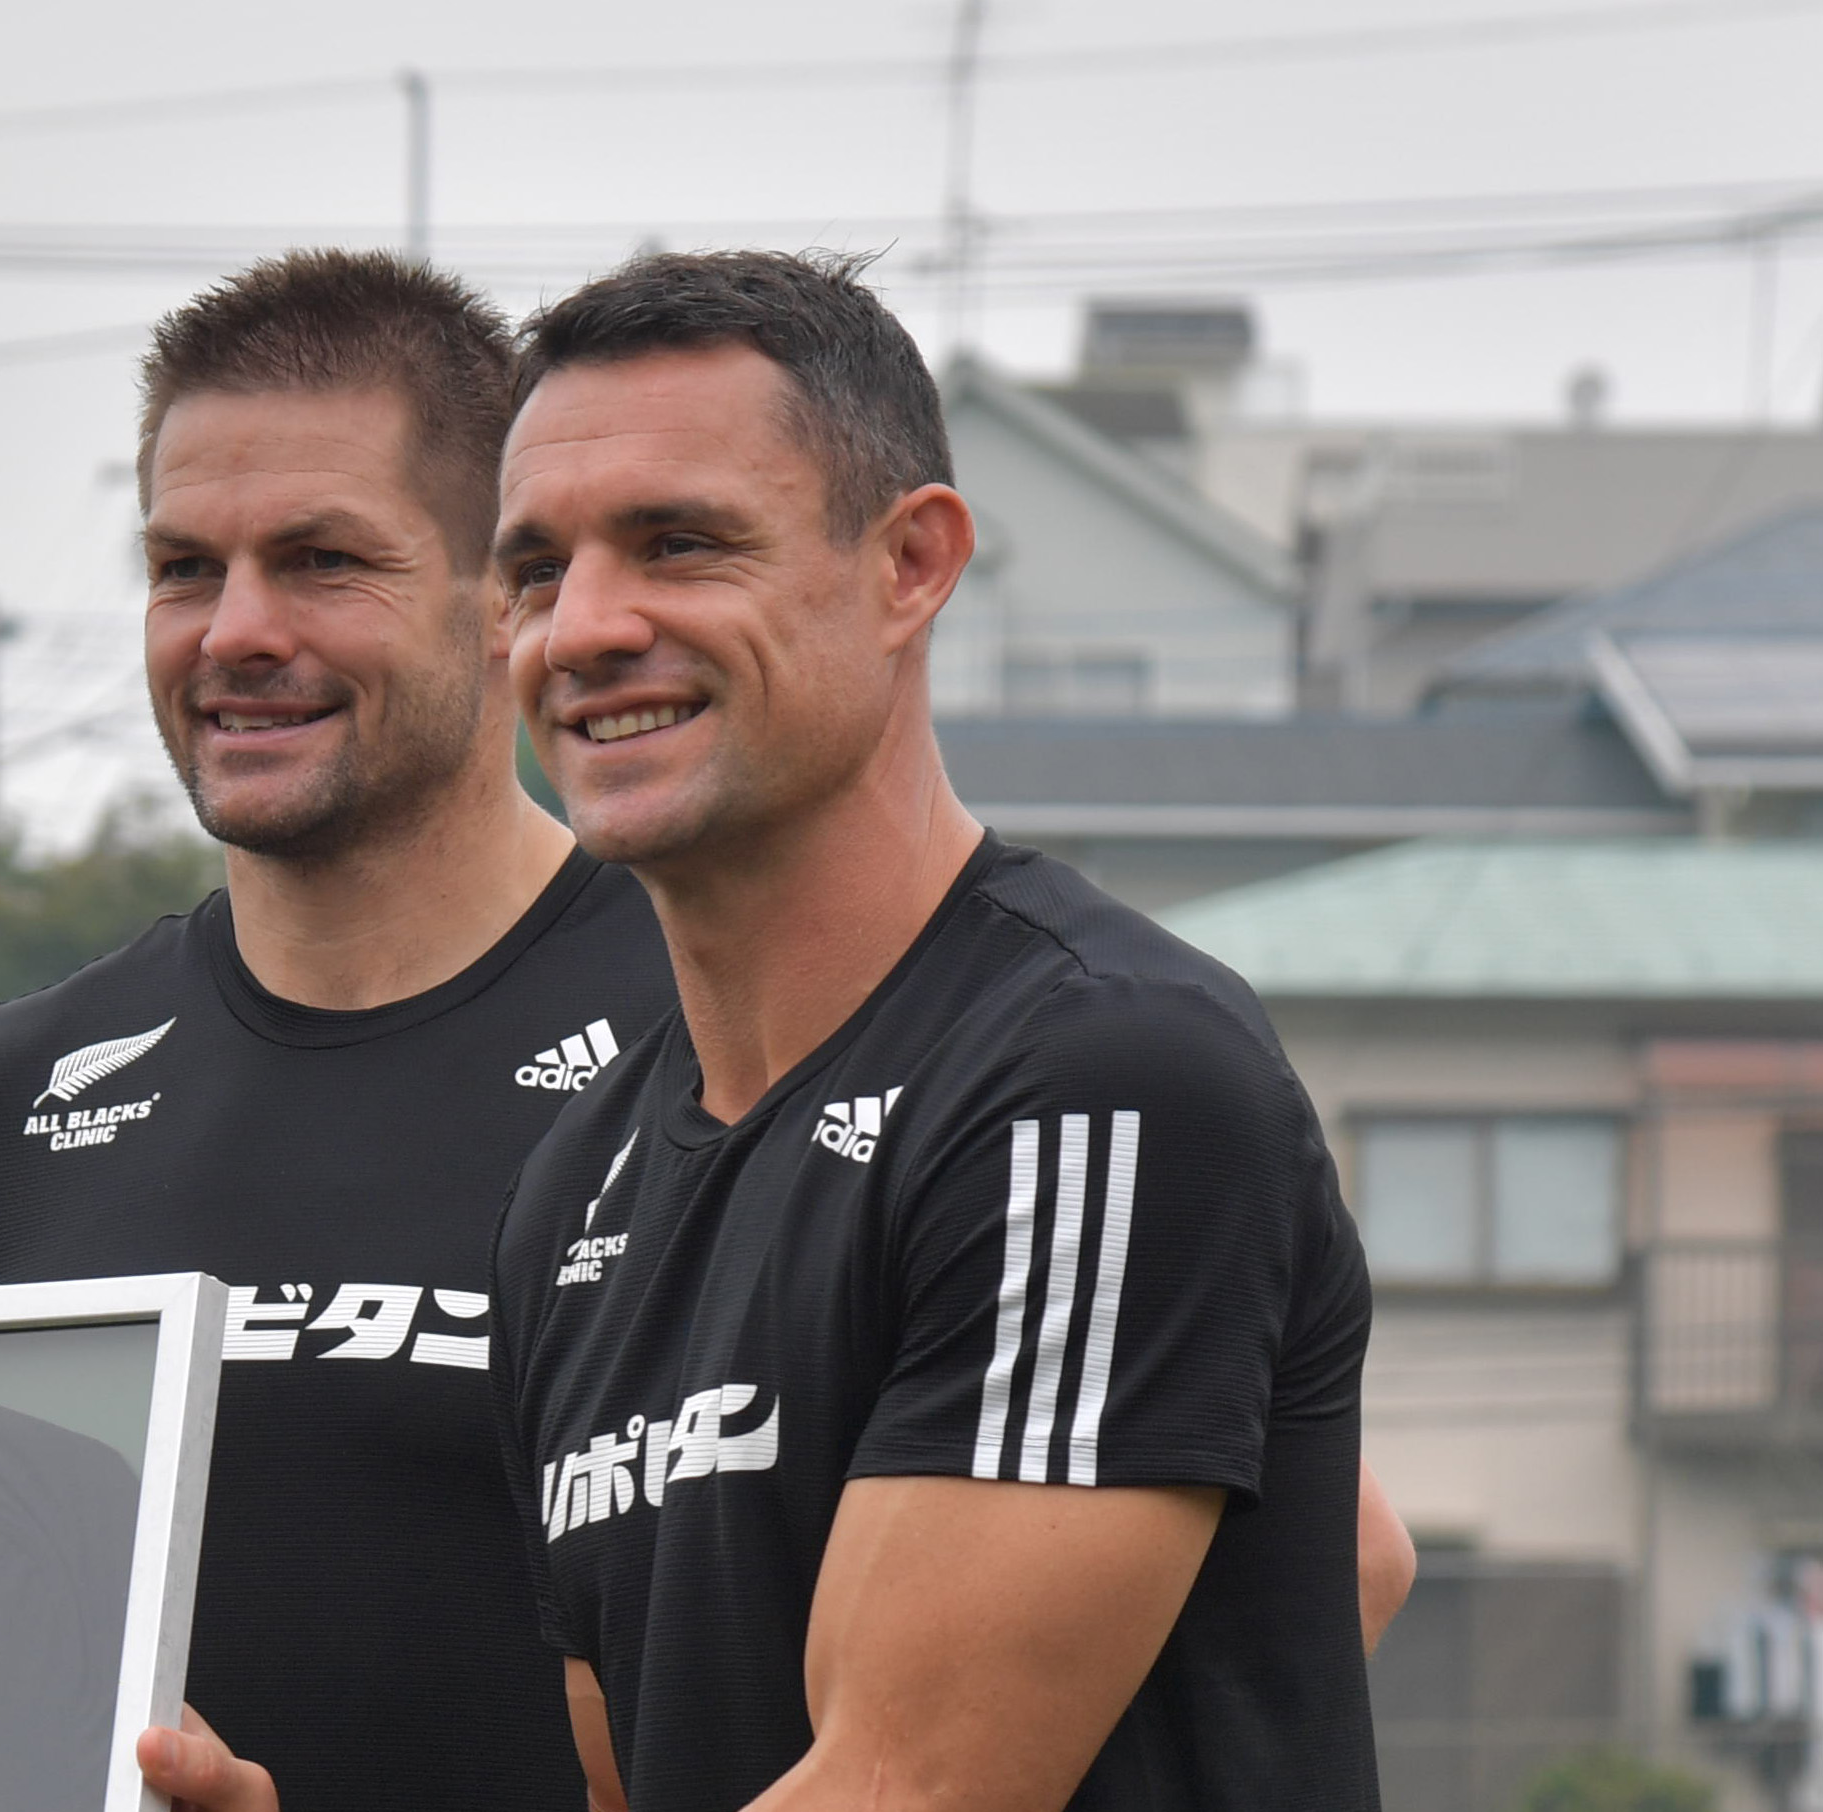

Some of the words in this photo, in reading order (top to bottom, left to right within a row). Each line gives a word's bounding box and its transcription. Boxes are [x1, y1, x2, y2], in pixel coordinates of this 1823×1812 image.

[24, 1114, 61, 1136] ALL
[66, 1100, 152, 1129] BLACKS
[50, 1124, 118, 1152] CLINIC
